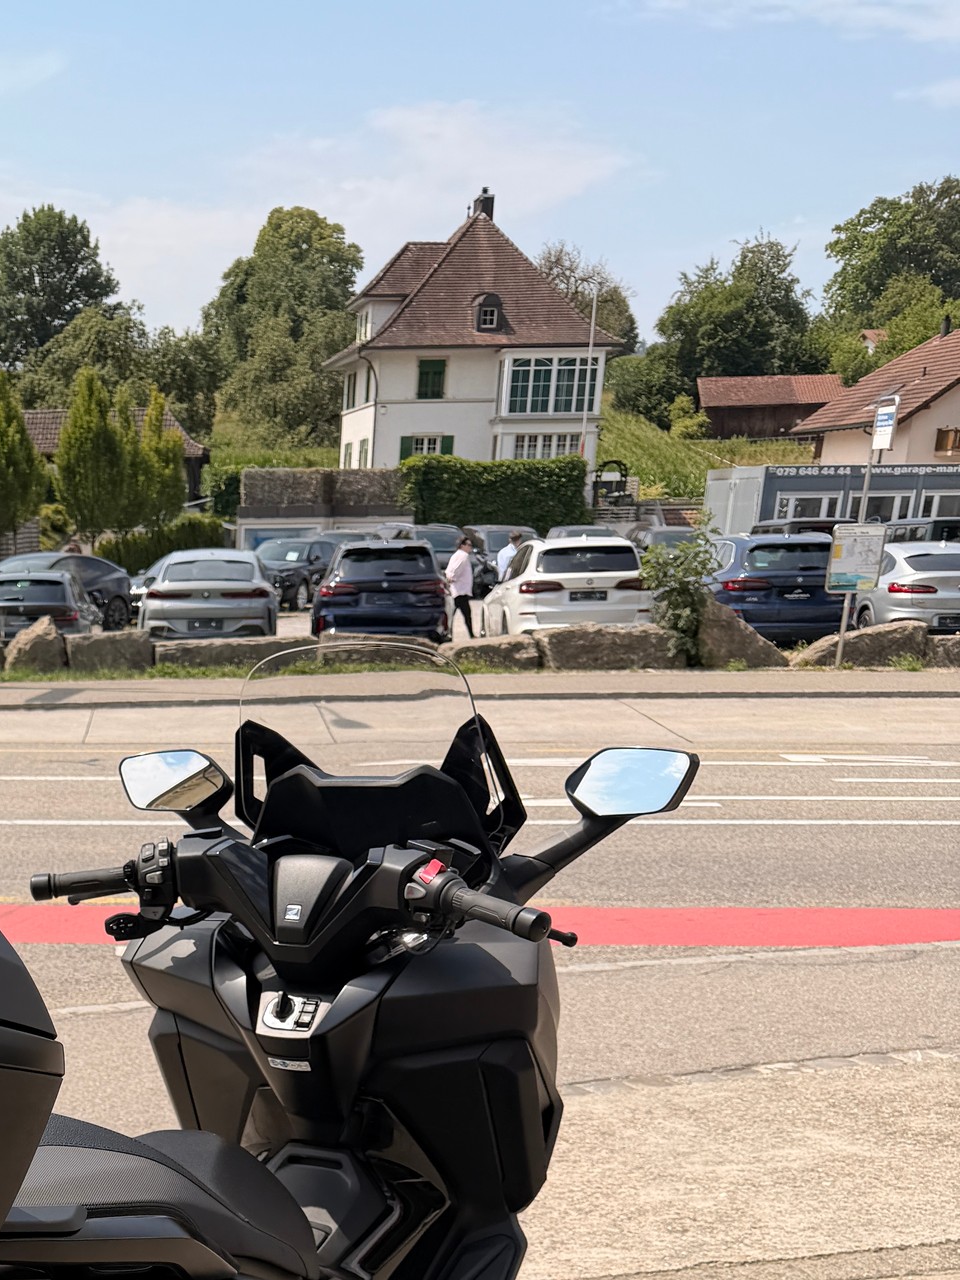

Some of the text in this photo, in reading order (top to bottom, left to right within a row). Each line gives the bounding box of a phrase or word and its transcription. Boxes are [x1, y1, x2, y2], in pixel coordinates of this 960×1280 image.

[776, 466, 797, 476] 079
[798, 466, 820, 476] 646
[821, 466, 835, 475] 44
[837, 466, 851, 475] 44
